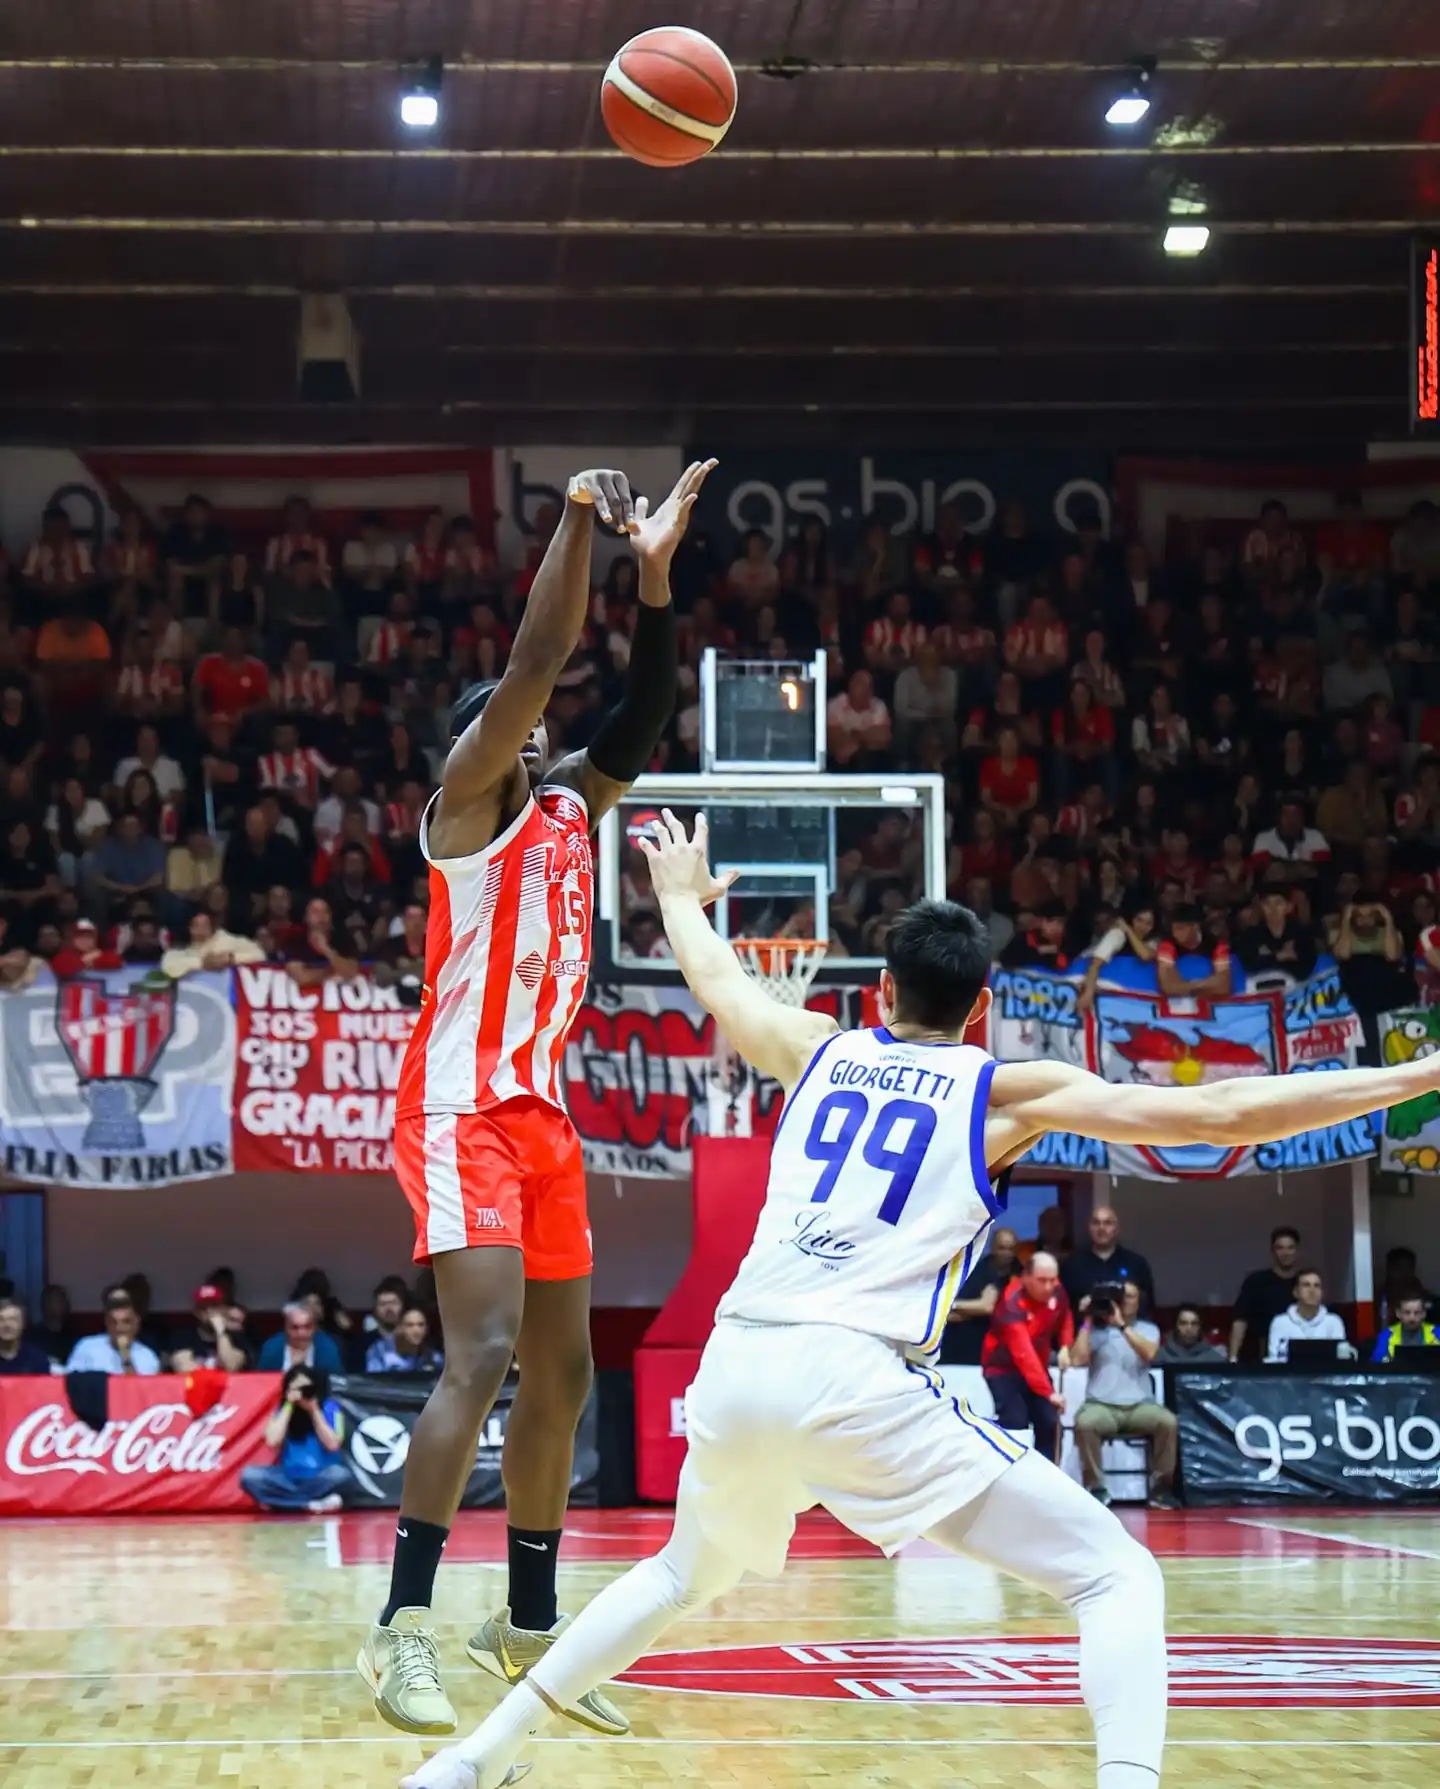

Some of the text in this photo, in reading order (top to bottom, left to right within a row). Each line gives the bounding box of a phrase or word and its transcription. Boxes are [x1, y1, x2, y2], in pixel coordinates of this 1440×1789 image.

[557, 890, 586, 938] 15
[993, 970, 1083, 1028] 1982
[250, 1011, 318, 1041] SOS
[829, 1059, 956, 1101] GIORGETTI
[101, 1141, 227, 1181] FARIAS
[804, 1090, 938, 1227] 99
[5, 1403, 239, 1475] Coca-Cola
[1234, 1398, 1440, 1482] gs.bio
